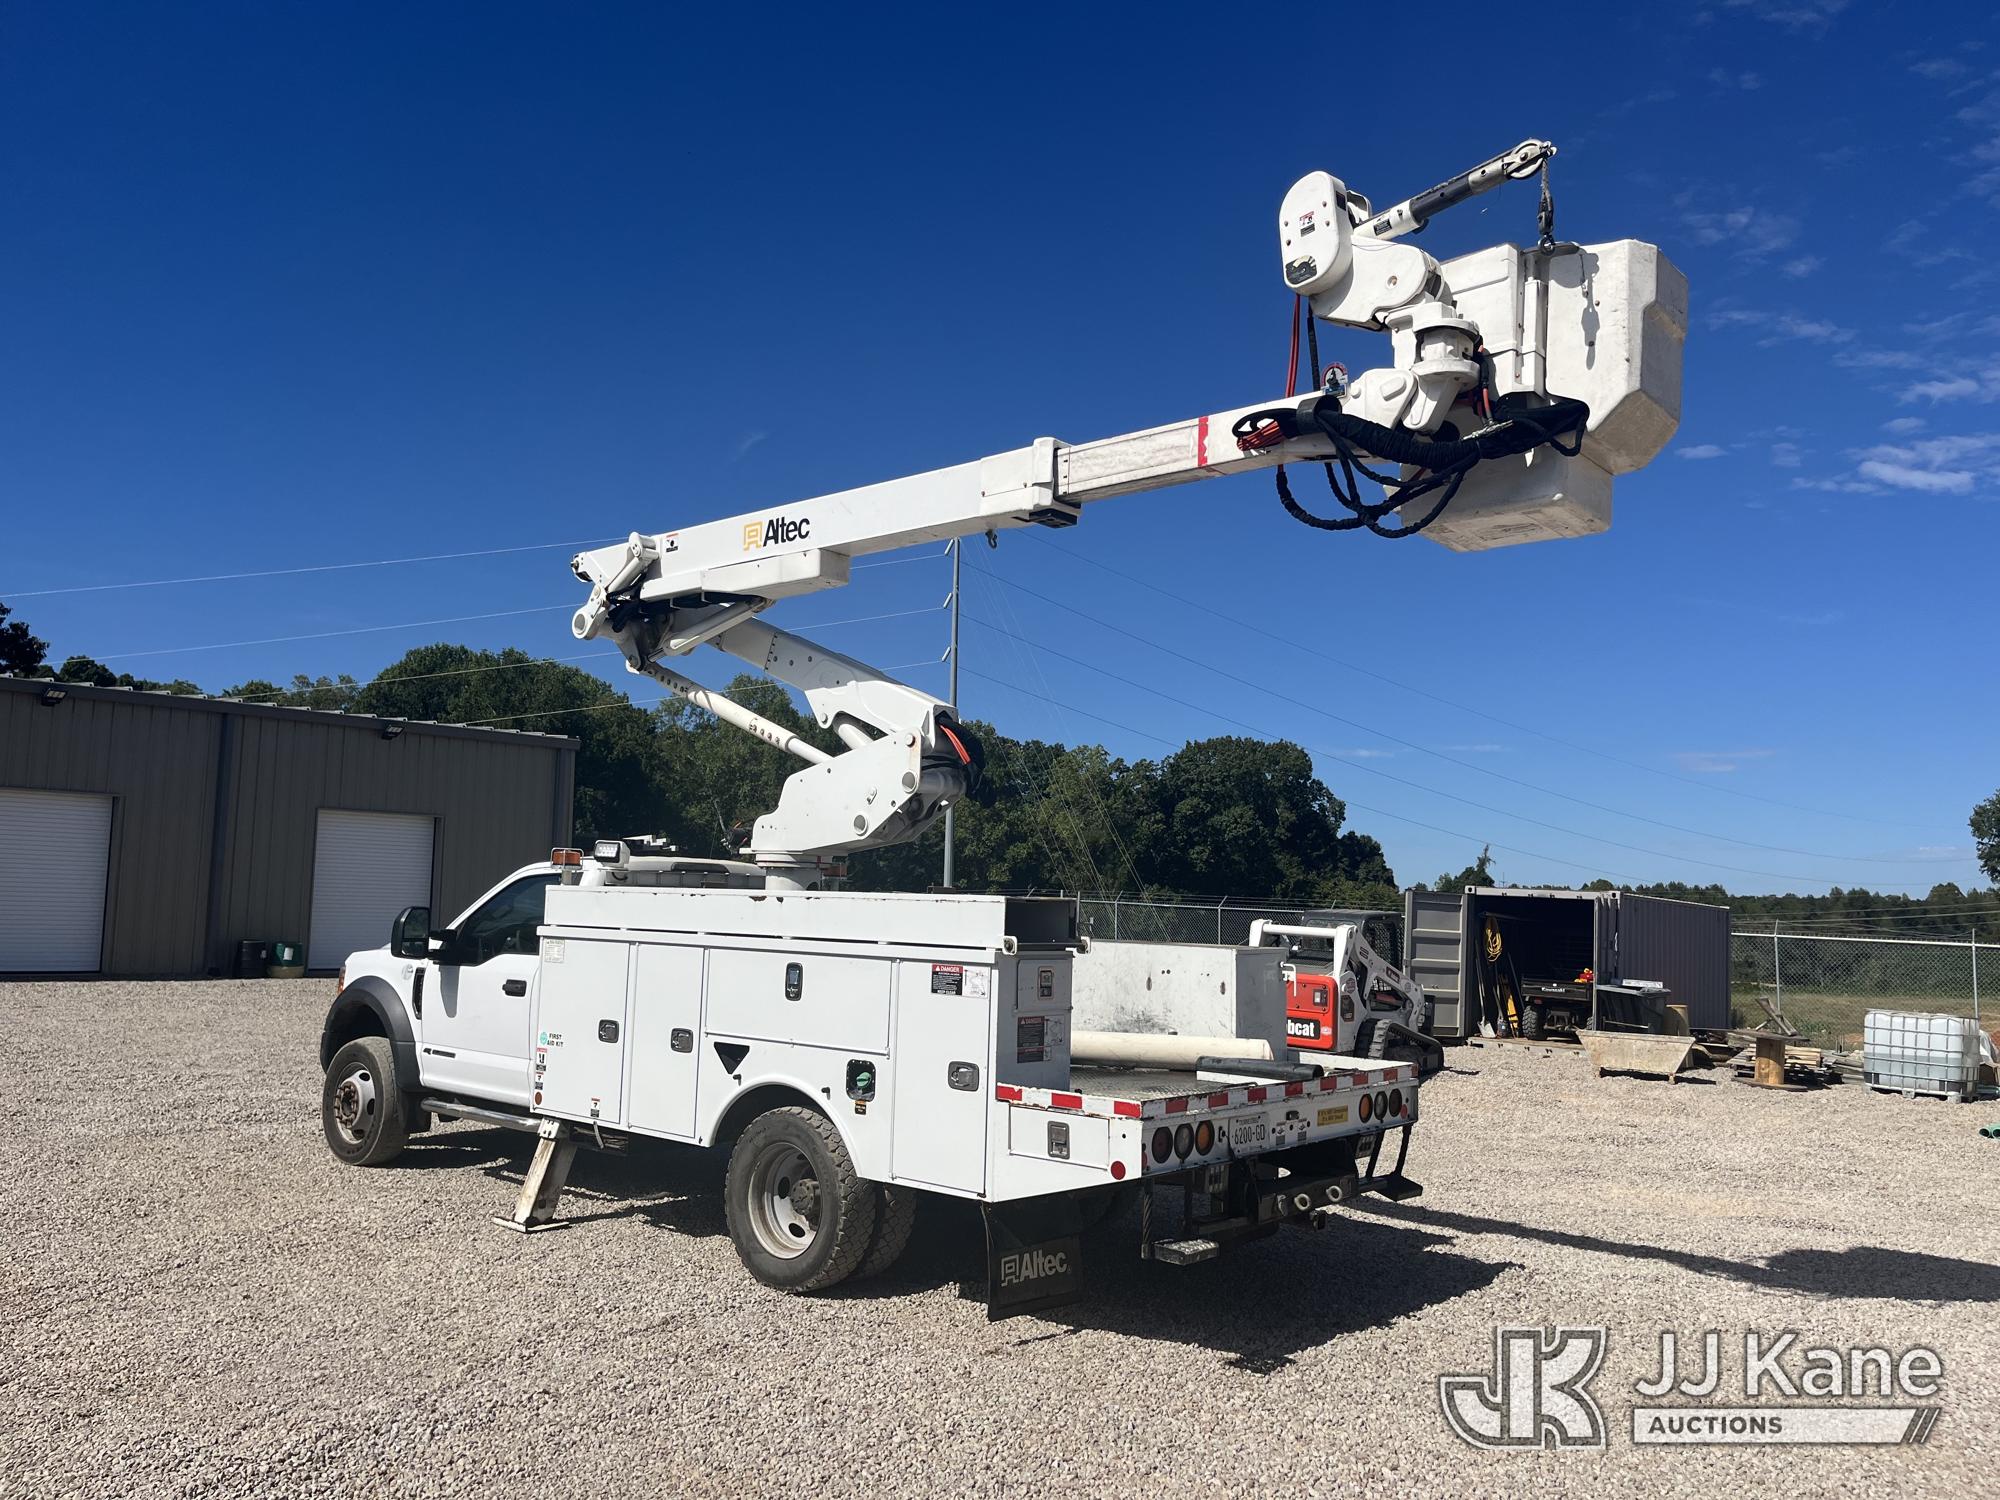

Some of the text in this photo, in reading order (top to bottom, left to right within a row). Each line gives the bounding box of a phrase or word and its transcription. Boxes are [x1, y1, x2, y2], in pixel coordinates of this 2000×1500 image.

[763, 516, 810, 547] Altec
[940, 965, 960, 973] DANGER
[1286, 1019, 1315, 1037] bcat
[1234, 1124, 1265, 1144] 6200-GD
[1020, 1249, 1068, 1282] Altec
